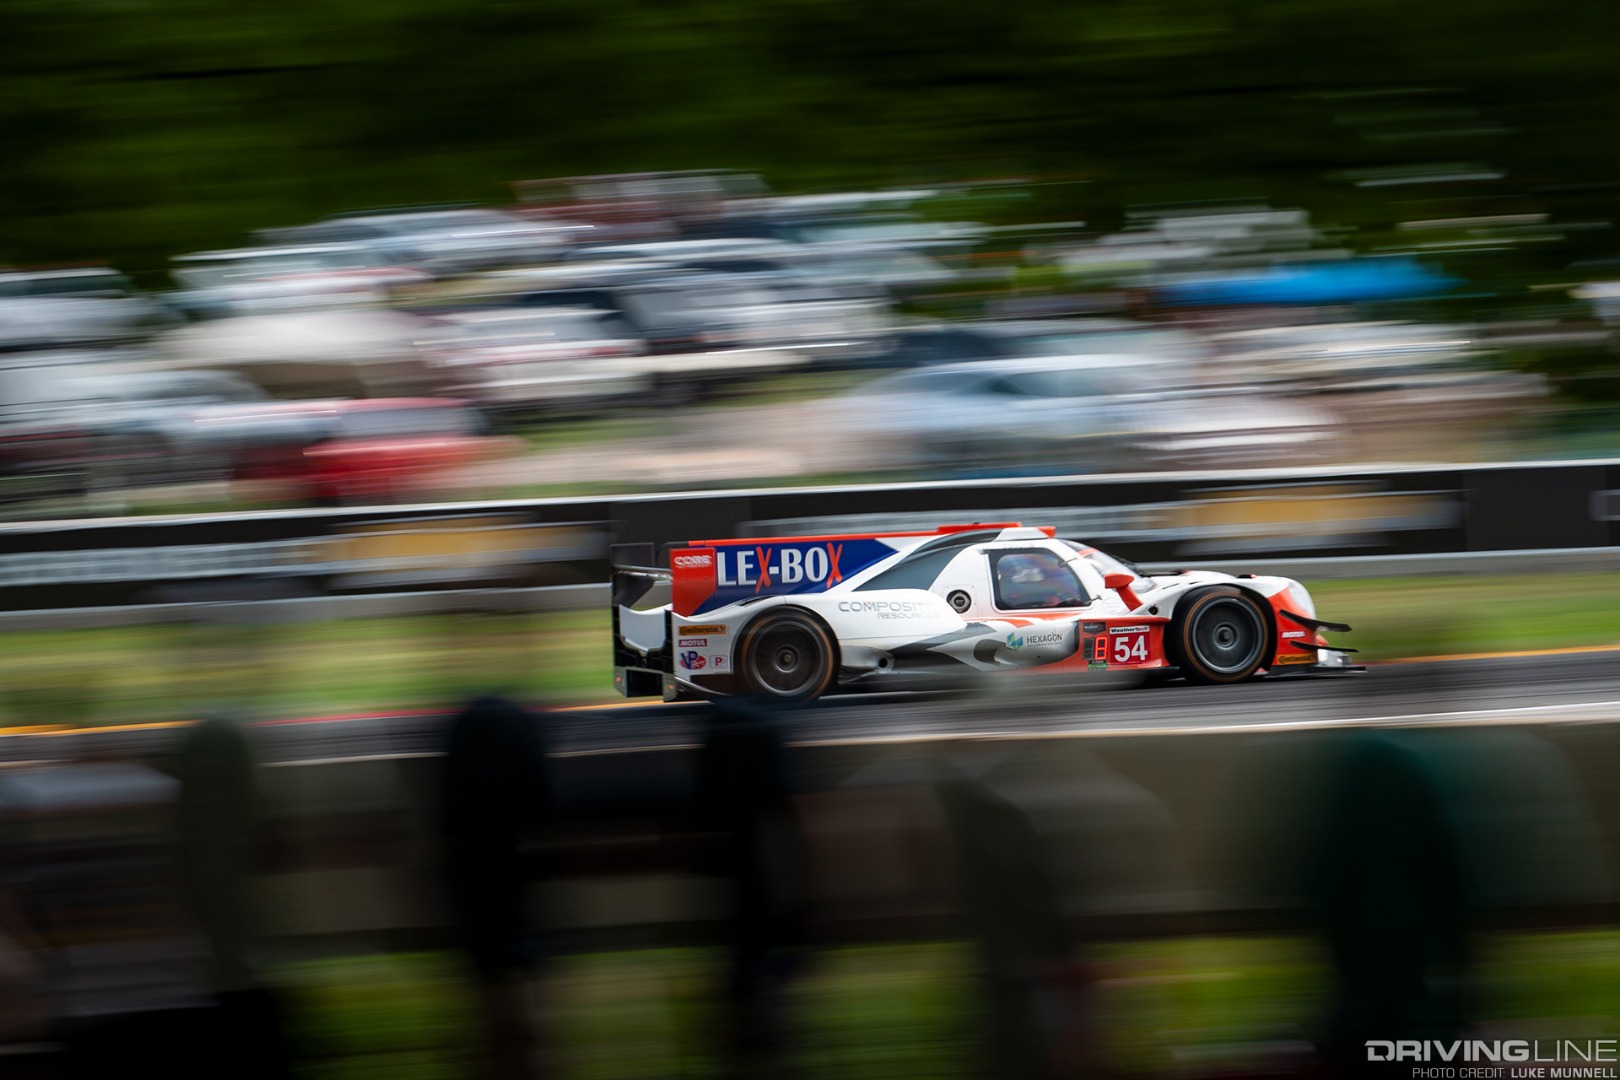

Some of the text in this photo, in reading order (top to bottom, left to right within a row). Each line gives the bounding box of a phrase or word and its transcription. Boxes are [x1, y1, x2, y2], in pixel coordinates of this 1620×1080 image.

[716, 542, 843, 594] LEX-BOX
[680, 639, 706, 647] MOTUL
[1026, 633, 1063, 644] HEXAGON
[1114, 635, 1148, 663] 54
